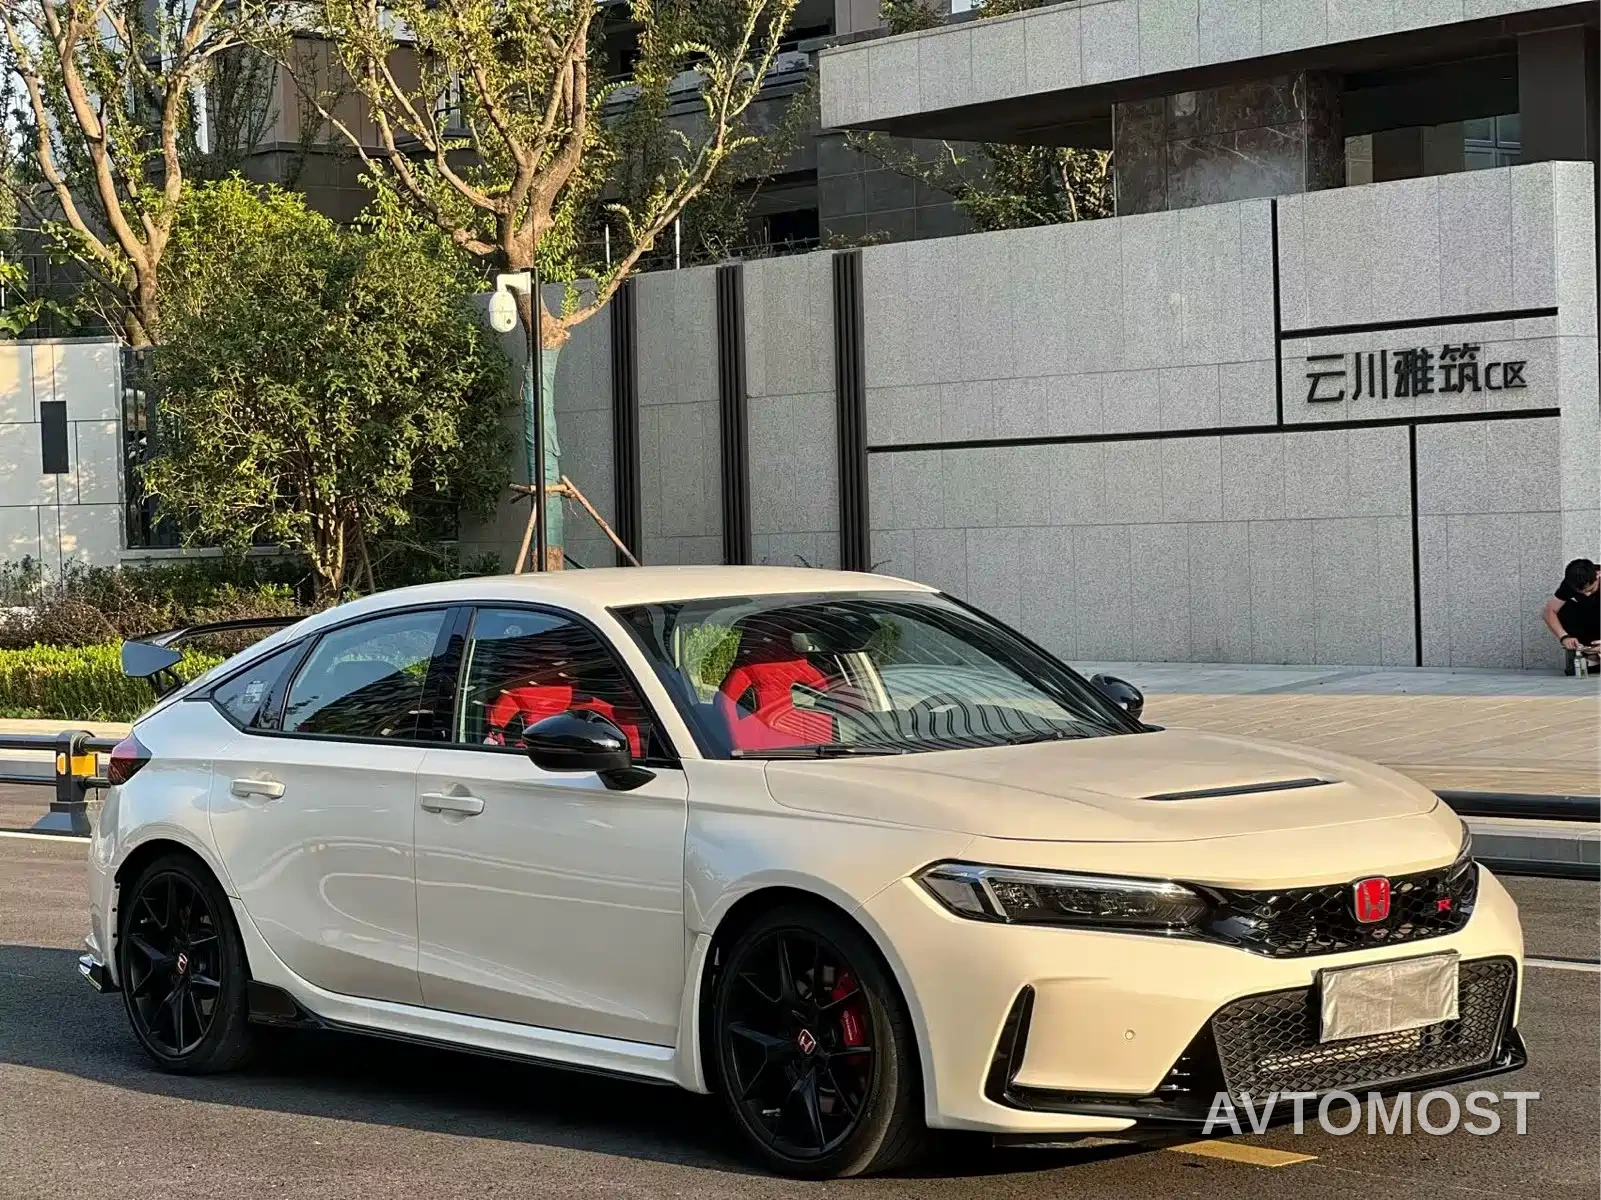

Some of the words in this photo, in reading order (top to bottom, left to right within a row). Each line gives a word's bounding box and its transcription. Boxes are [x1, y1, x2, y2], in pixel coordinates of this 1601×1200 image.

[1306, 343, 1527, 403] 云川雅筑C区
[1436, 898, 1452, 912] R
